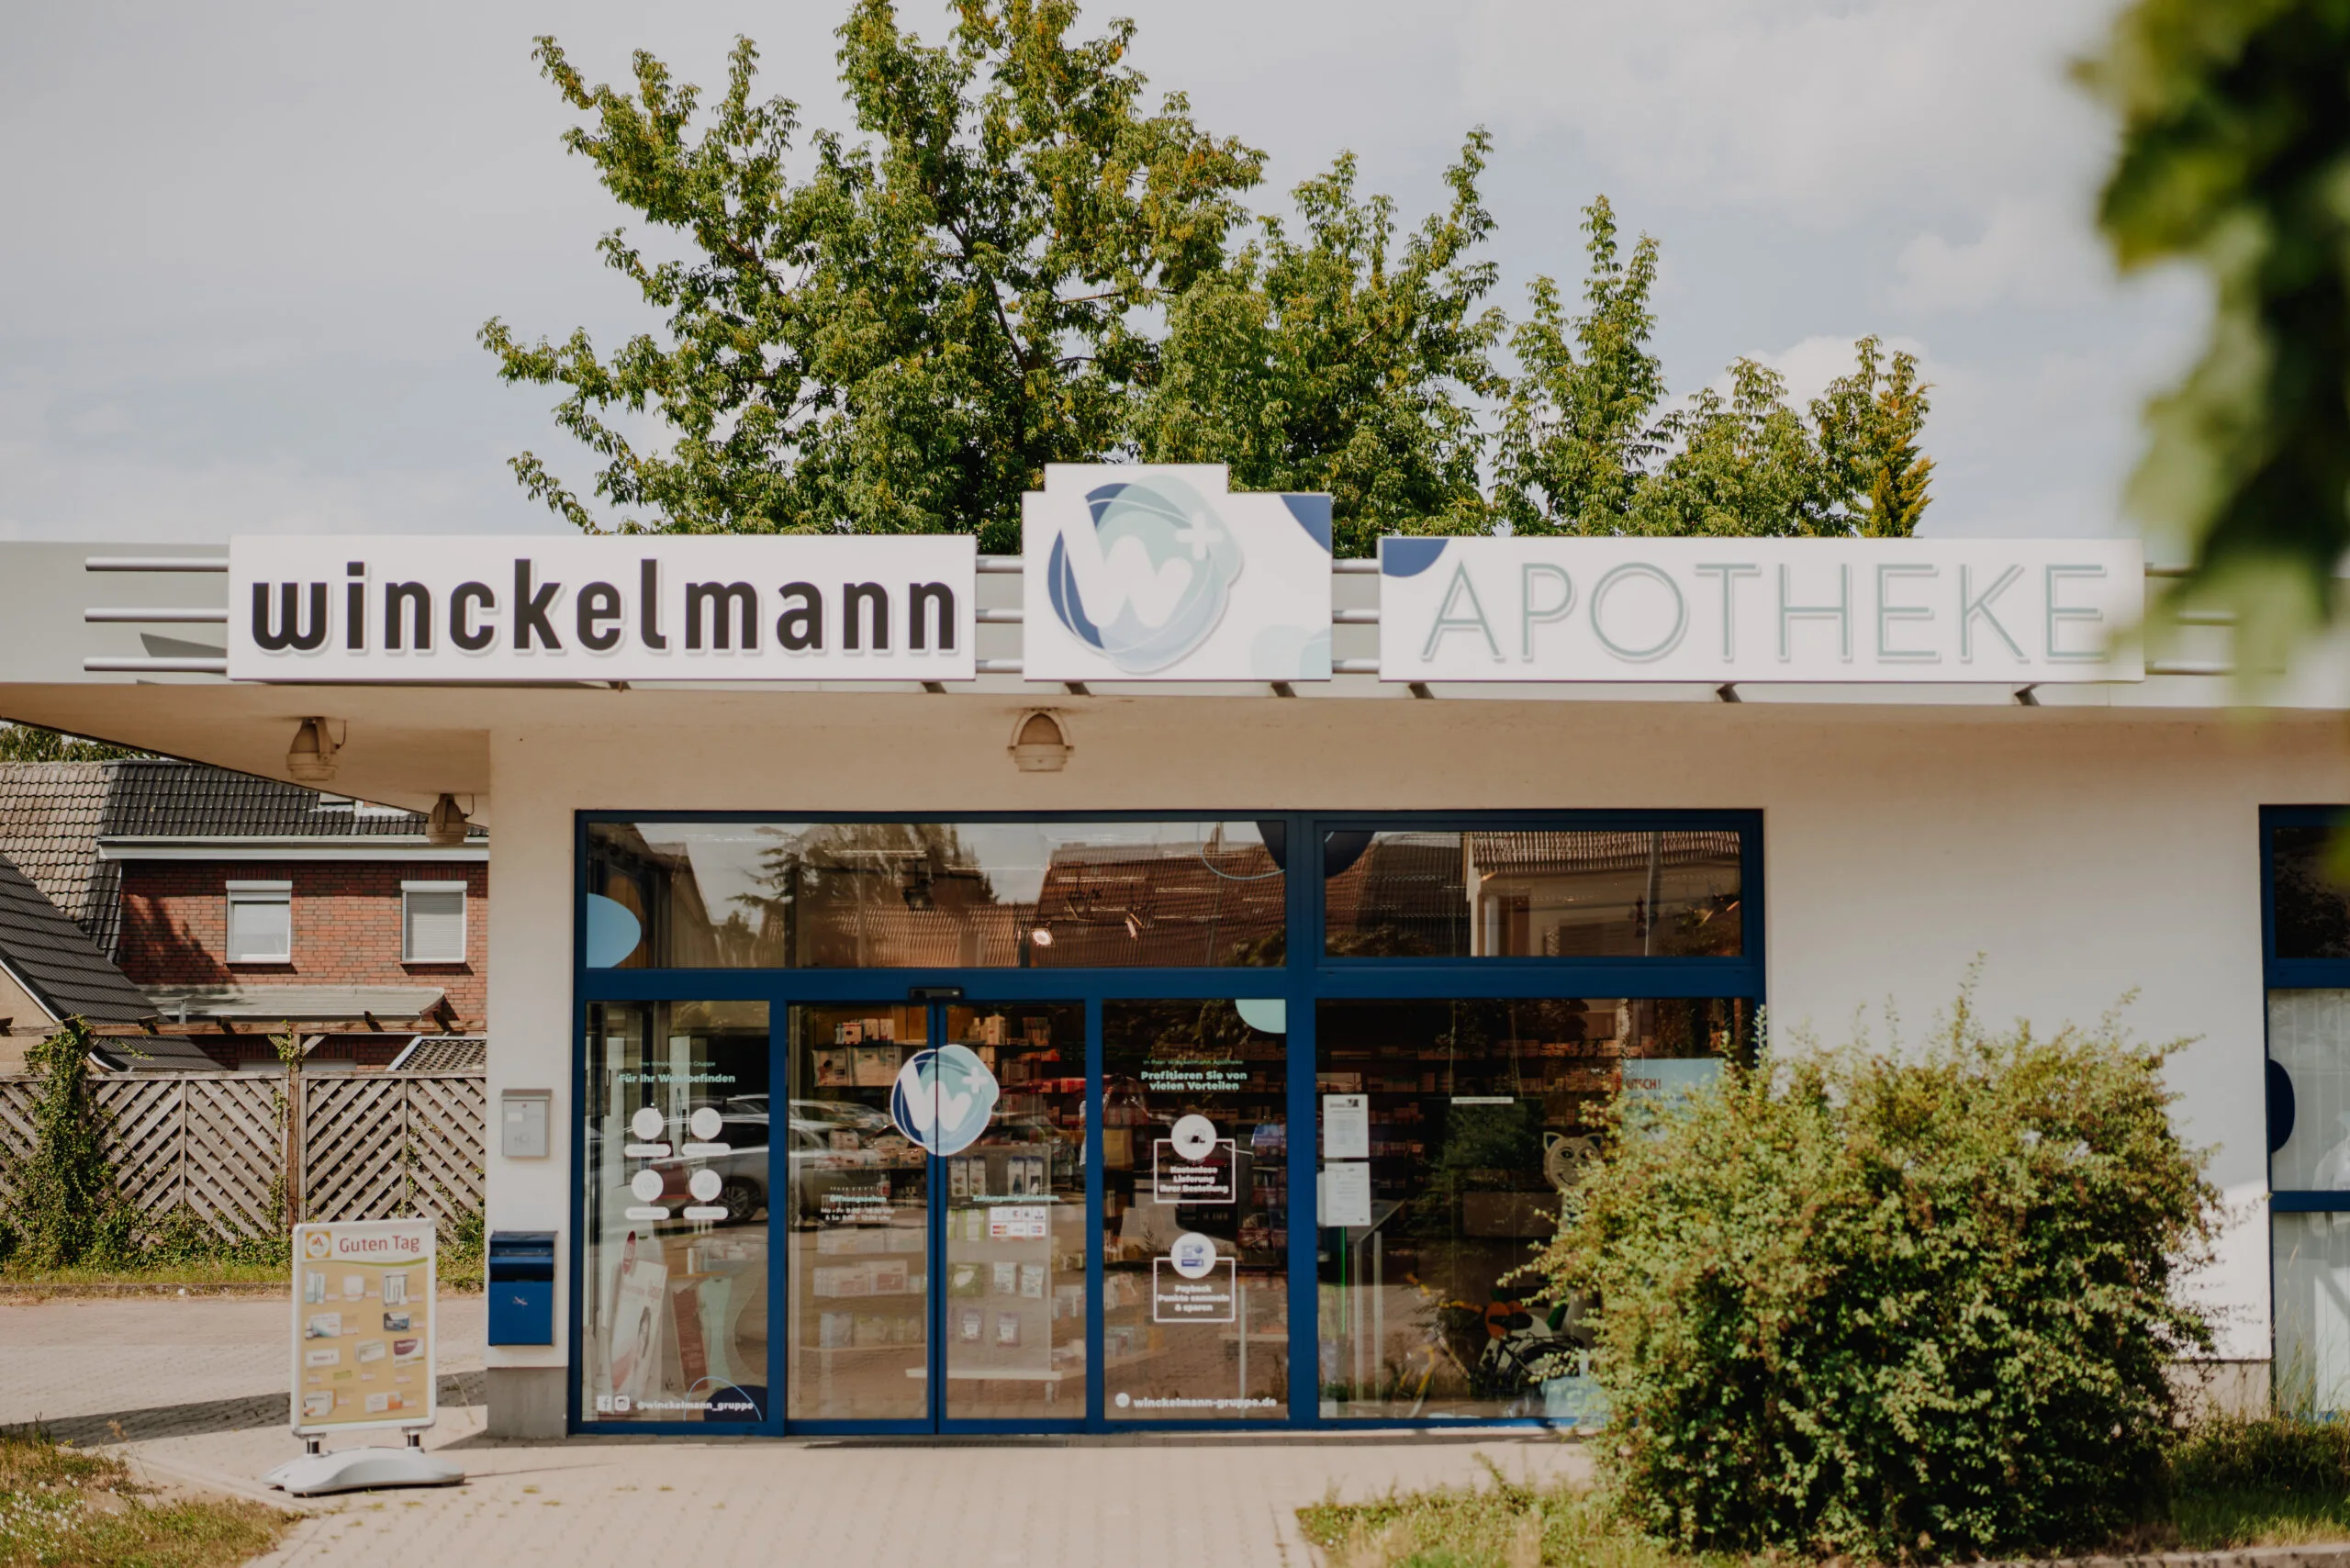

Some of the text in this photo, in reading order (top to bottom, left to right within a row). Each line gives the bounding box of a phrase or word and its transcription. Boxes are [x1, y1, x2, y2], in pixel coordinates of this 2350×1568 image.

[251, 558, 957, 653] winckelmann
[1420, 559, 2109, 662] APOTHEKE
[618, 1072, 736, 1083] Für Ihr Wohlbefinden
[1140, 1070, 1248, 1081] Profitieren Sie von
[1148, 1081, 1240, 1091] vielen Vorteilen
[1169, 1165, 1218, 1174] Kostenlose
[1172, 1175, 1216, 1184] Lieferung
[1181, 1183, 1229, 1193] Bestellung
[339, 1235, 420, 1253] Guten Tag
[1133, 1396, 1278, 1409] winckelmann-gruppe.de
